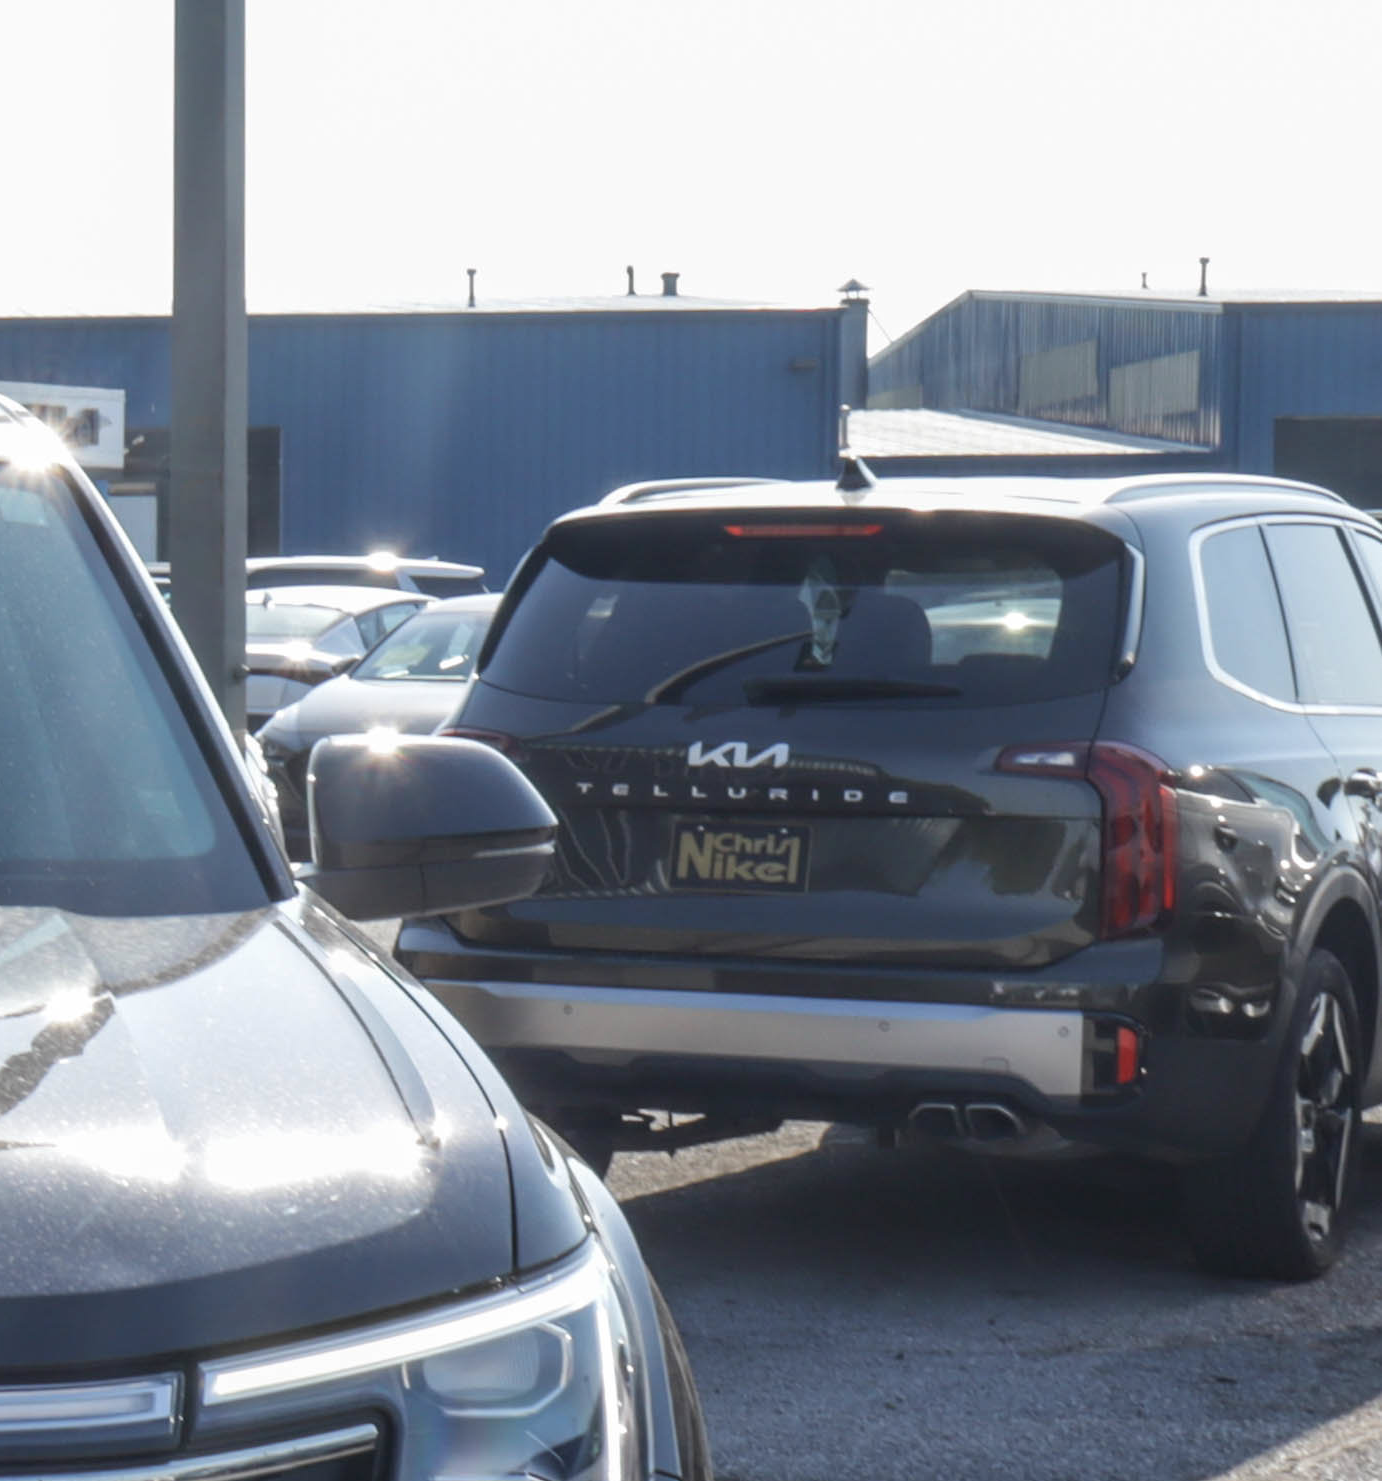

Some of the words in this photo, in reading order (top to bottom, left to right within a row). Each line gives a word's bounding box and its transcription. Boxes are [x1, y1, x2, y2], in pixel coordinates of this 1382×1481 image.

[688, 741, 789, 768] KIA
[576, 782, 909, 804] TELLURIDE
[712, 832, 789, 854] Chris
[677, 831, 801, 884] Nikel
